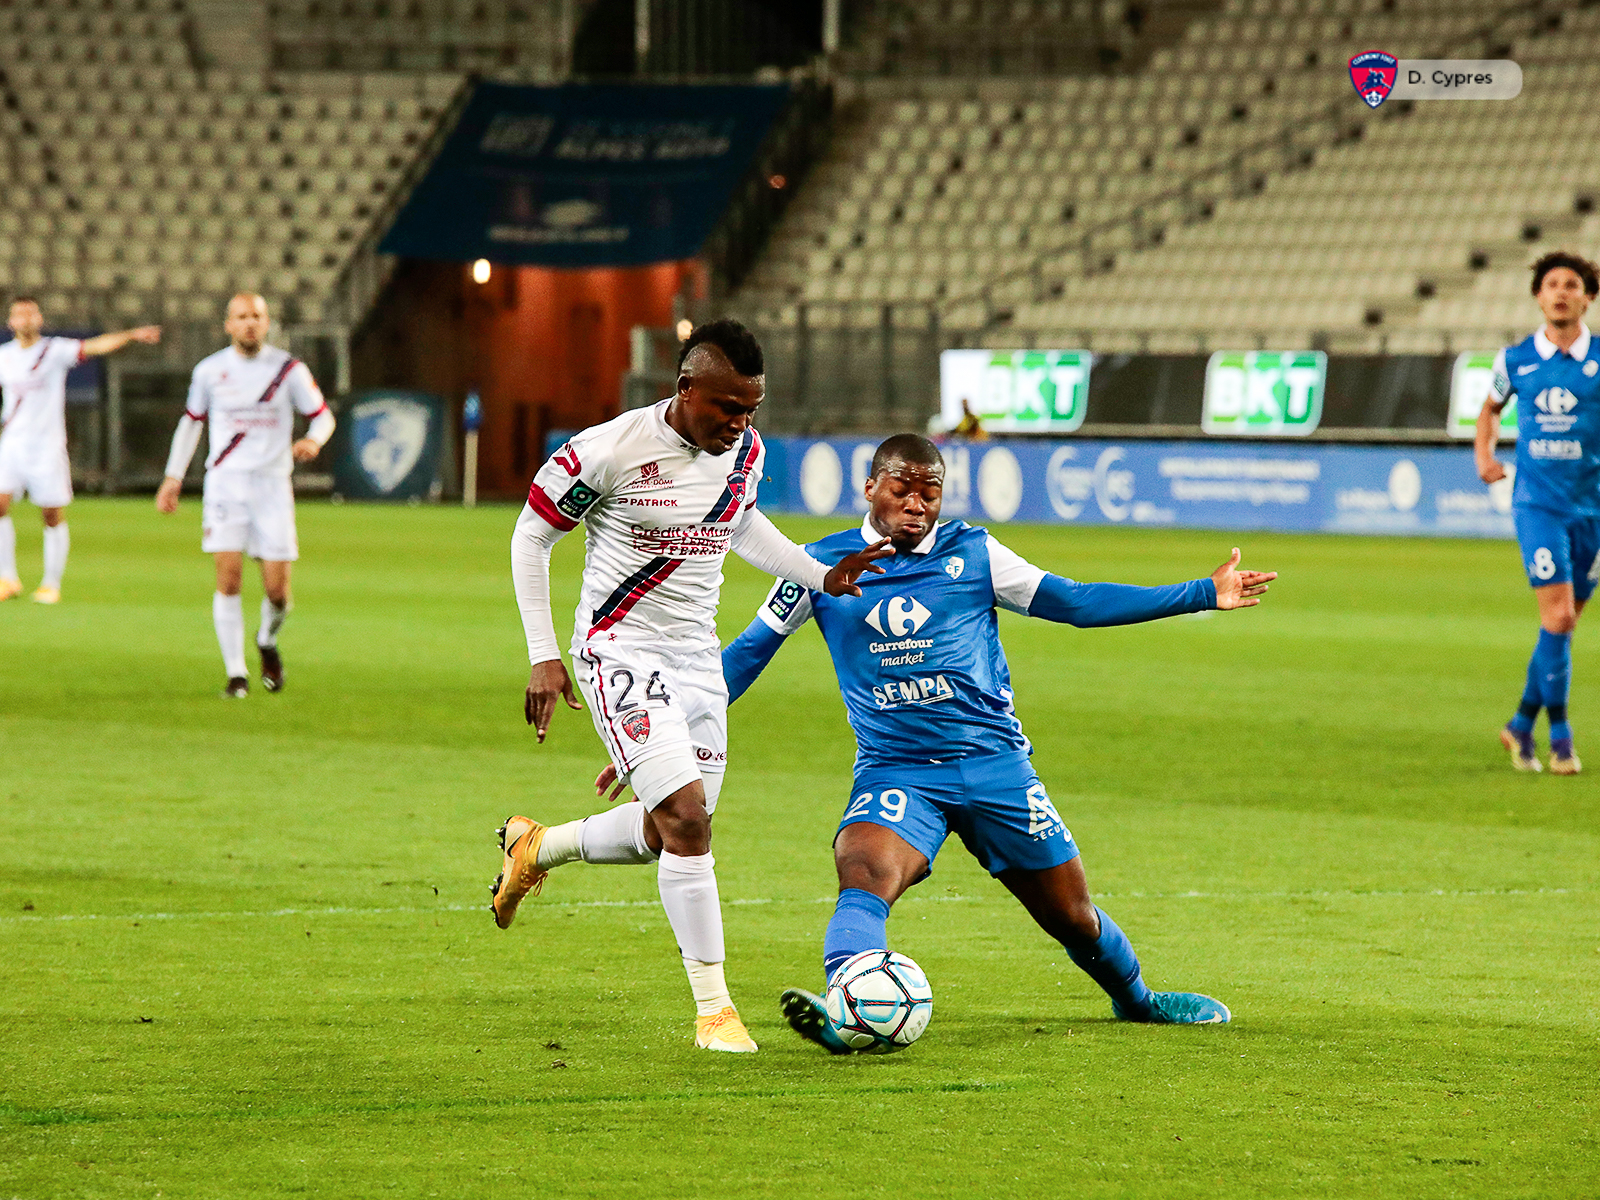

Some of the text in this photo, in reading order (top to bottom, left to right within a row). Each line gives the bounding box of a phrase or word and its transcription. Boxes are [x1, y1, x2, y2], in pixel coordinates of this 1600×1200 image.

[630, 498, 678, 507] PATRICK
[630, 524, 681, 538] Crédit
[869, 638, 934, 654] Carrefour
[881, 651, 925, 667] market
[610, 669, 671, 713] 24
[872, 674, 953, 706] SEMPA
[843, 788, 909, 823] 29
